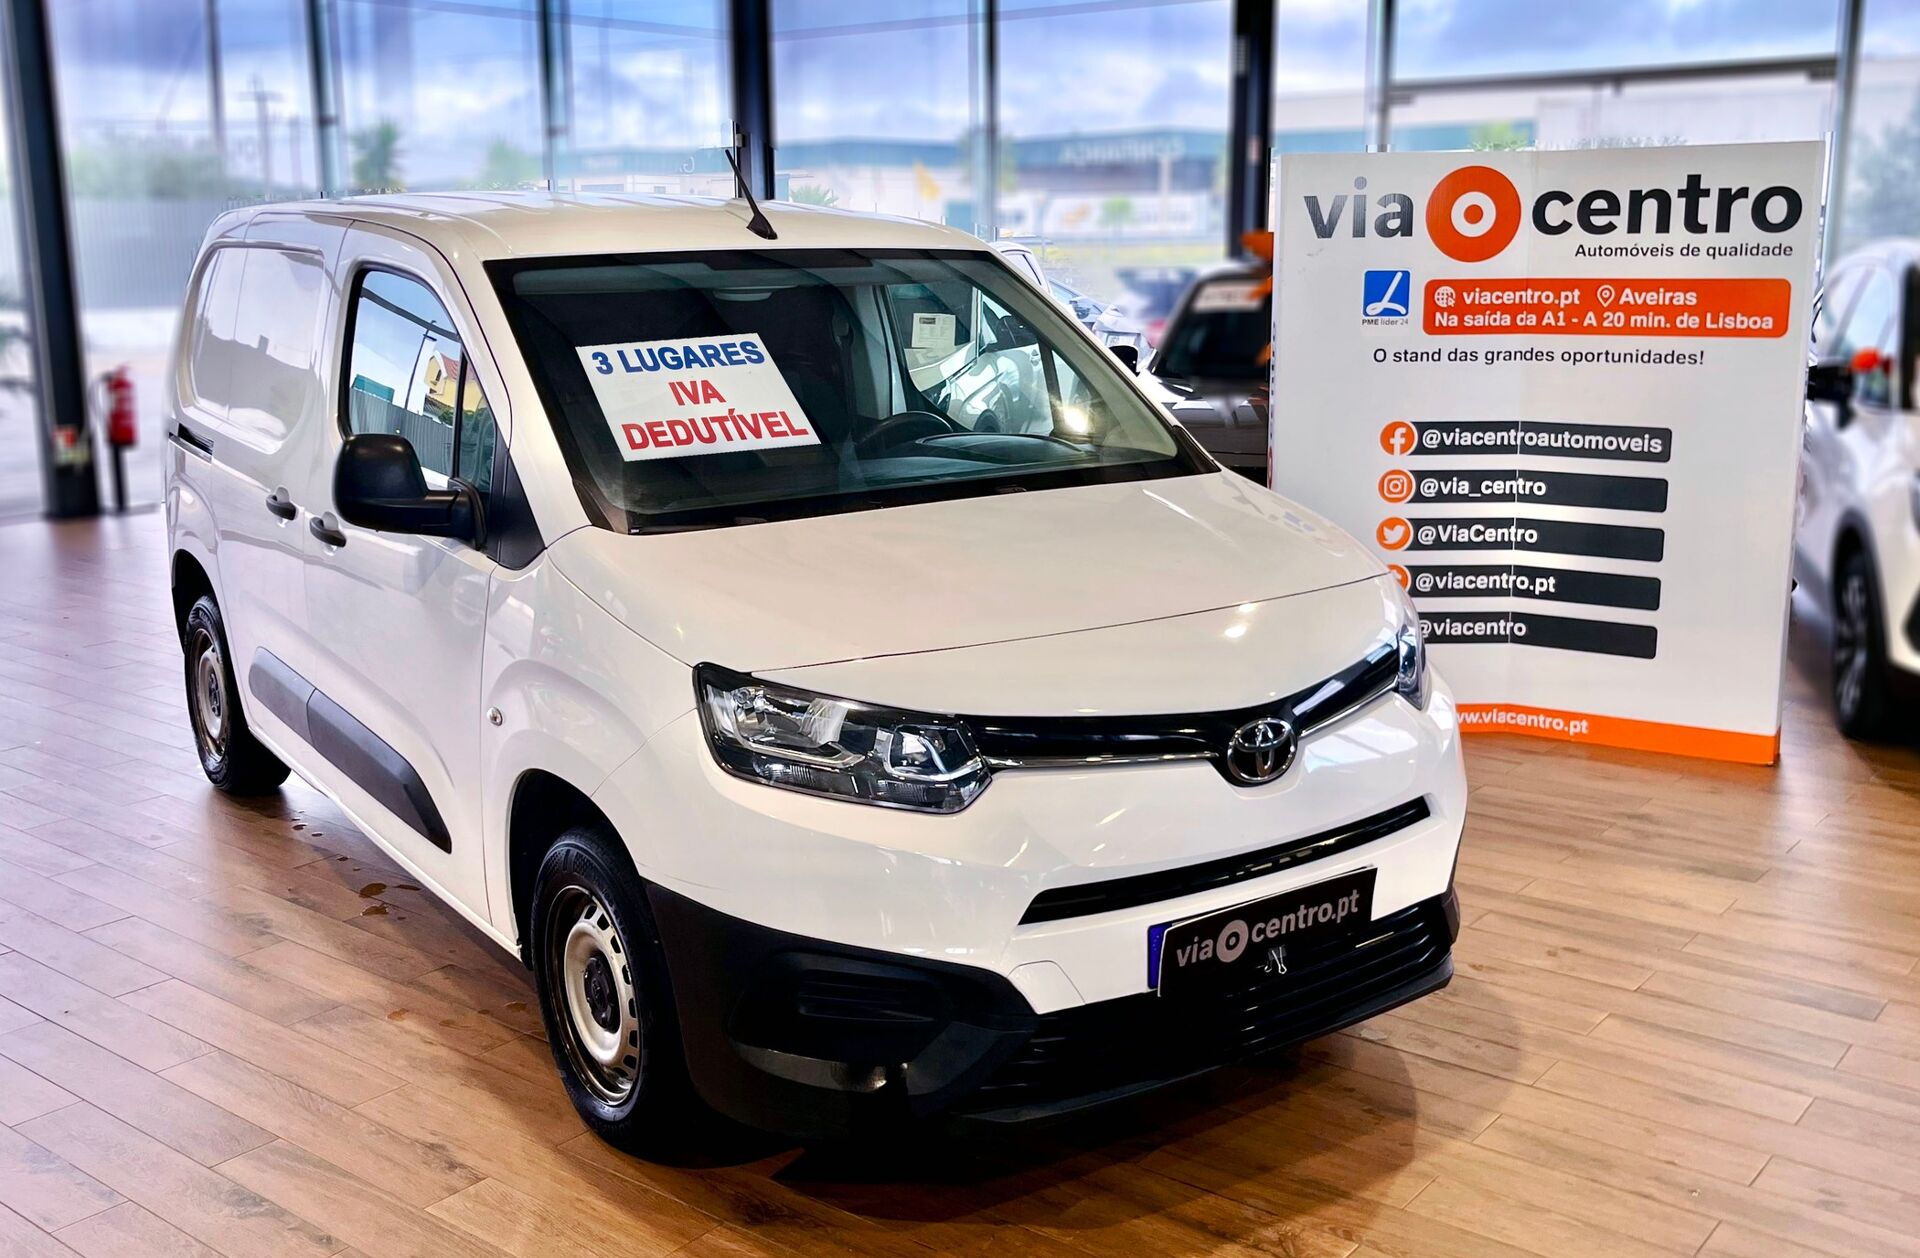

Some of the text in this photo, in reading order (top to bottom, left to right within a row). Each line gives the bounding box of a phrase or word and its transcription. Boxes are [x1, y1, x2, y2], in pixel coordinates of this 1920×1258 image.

[1303, 173, 1803, 239] via centro
[1575, 243, 1793, 260] Automóveis de qualidade
[1463, 287, 1697, 306] viacentro.pt Aveiras
[1362, 318, 1379, 326] PME
[1435, 311, 1458, 327] Na
[1464, 310, 1511, 327] saída
[1516, 311, 1537, 327] da
[1542, 311, 1566, 327] A1
[1583, 312, 1598, 327] A
[1602, 312, 1625, 328] 20
[1630, 312, 1671, 328] min.
[1676, 312, 1699, 329] de
[1706, 312, 1773, 330] Lisboa
[591, 340, 765, 375] 3 LUGARES
[1373, 347, 1704, 366] O stand das grandes oportunidades!
[668, 379, 727, 406] IVA
[621, 408, 809, 450] DEDUTÍVEL
[1422, 428, 1663, 454] @viacentroautomoveis
[1420, 477, 1547, 498] @via_centro
[1417, 524, 1538, 545] @ViaCentro
[1415, 572, 1556, 595] @viacentro.pt
[1176, 889, 1360, 967] via centro.pt
